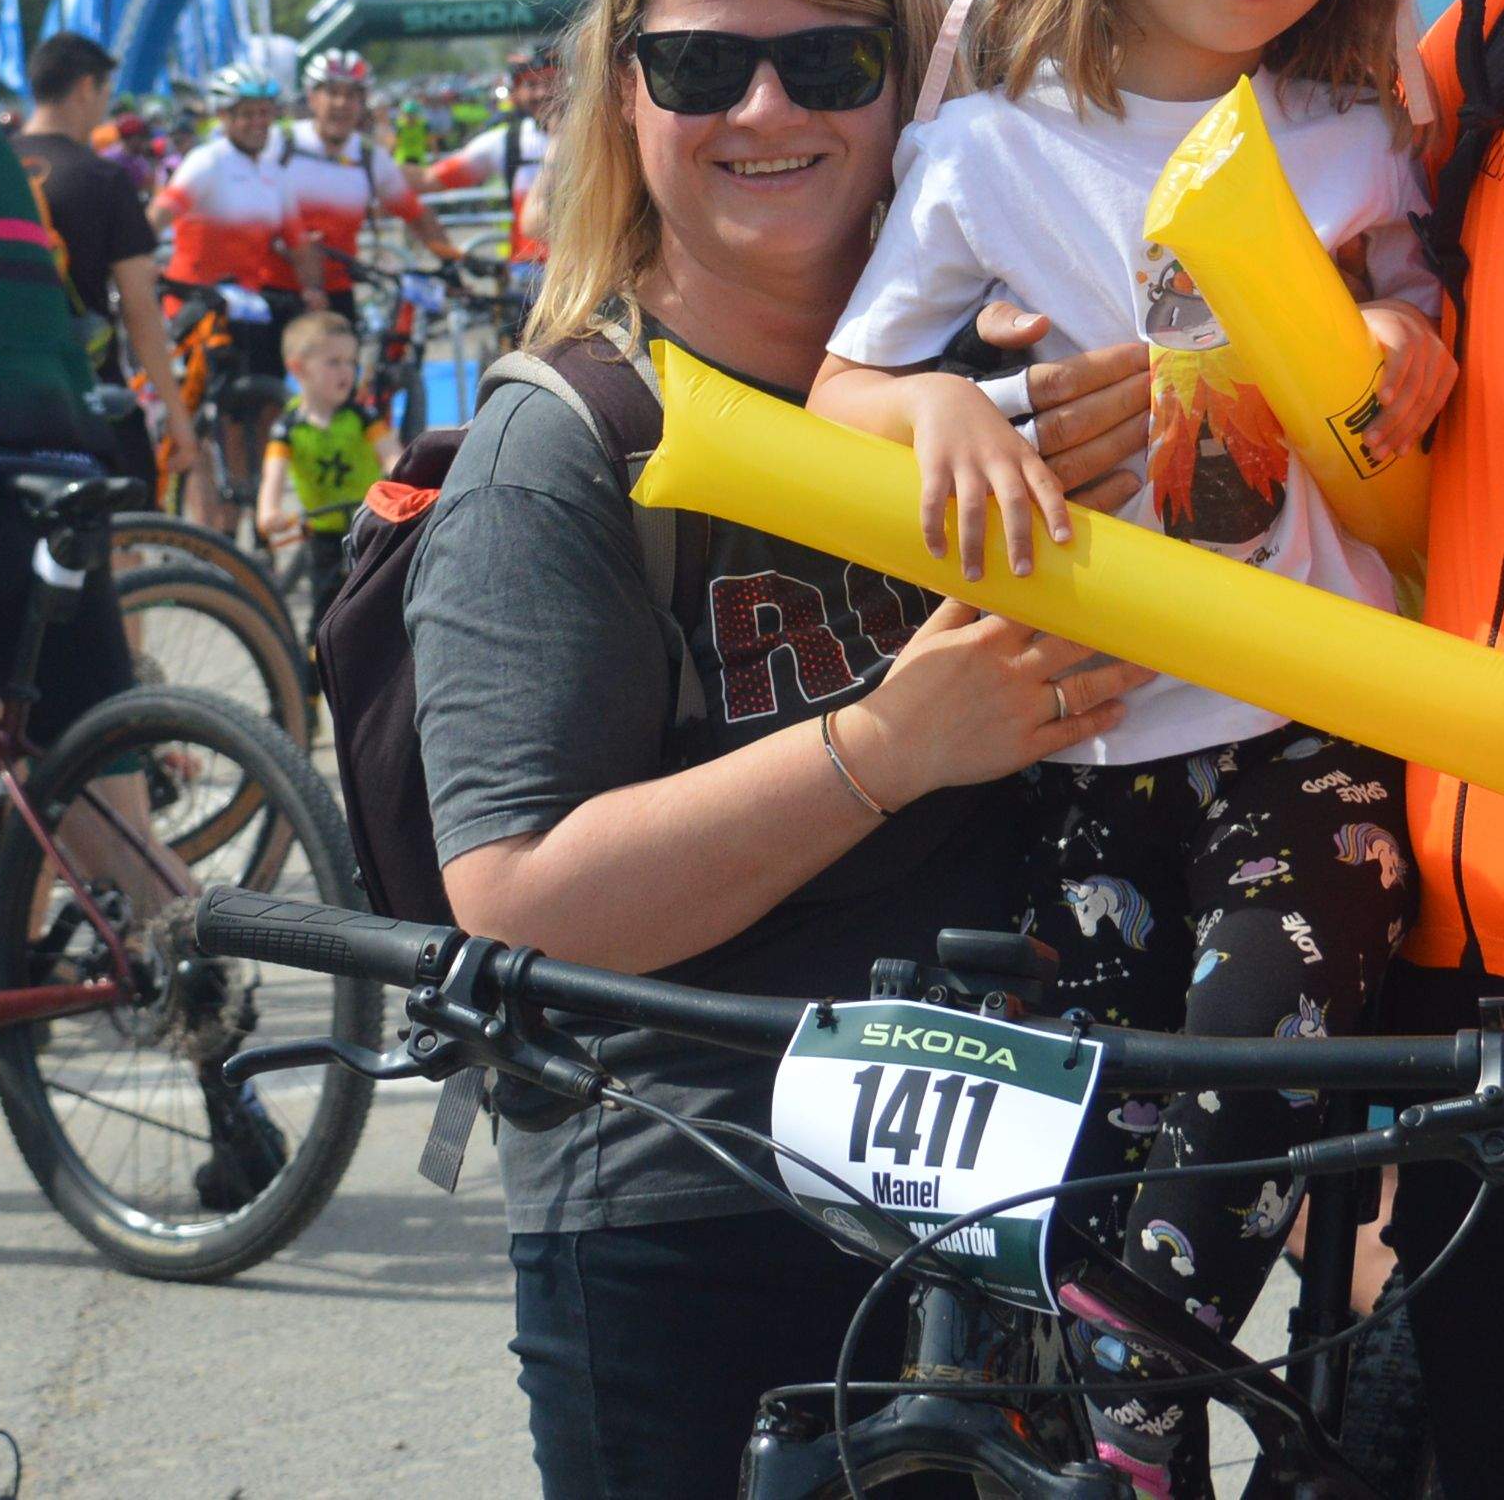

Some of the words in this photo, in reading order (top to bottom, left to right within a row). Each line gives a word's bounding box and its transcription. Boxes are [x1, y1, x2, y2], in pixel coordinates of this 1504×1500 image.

[1281, 911, 1324, 965] LOVE
[860, 1022, 1017, 1073] SKODA
[848, 1064, 1000, 1171] 1411
[871, 1171, 942, 1209] Manel
